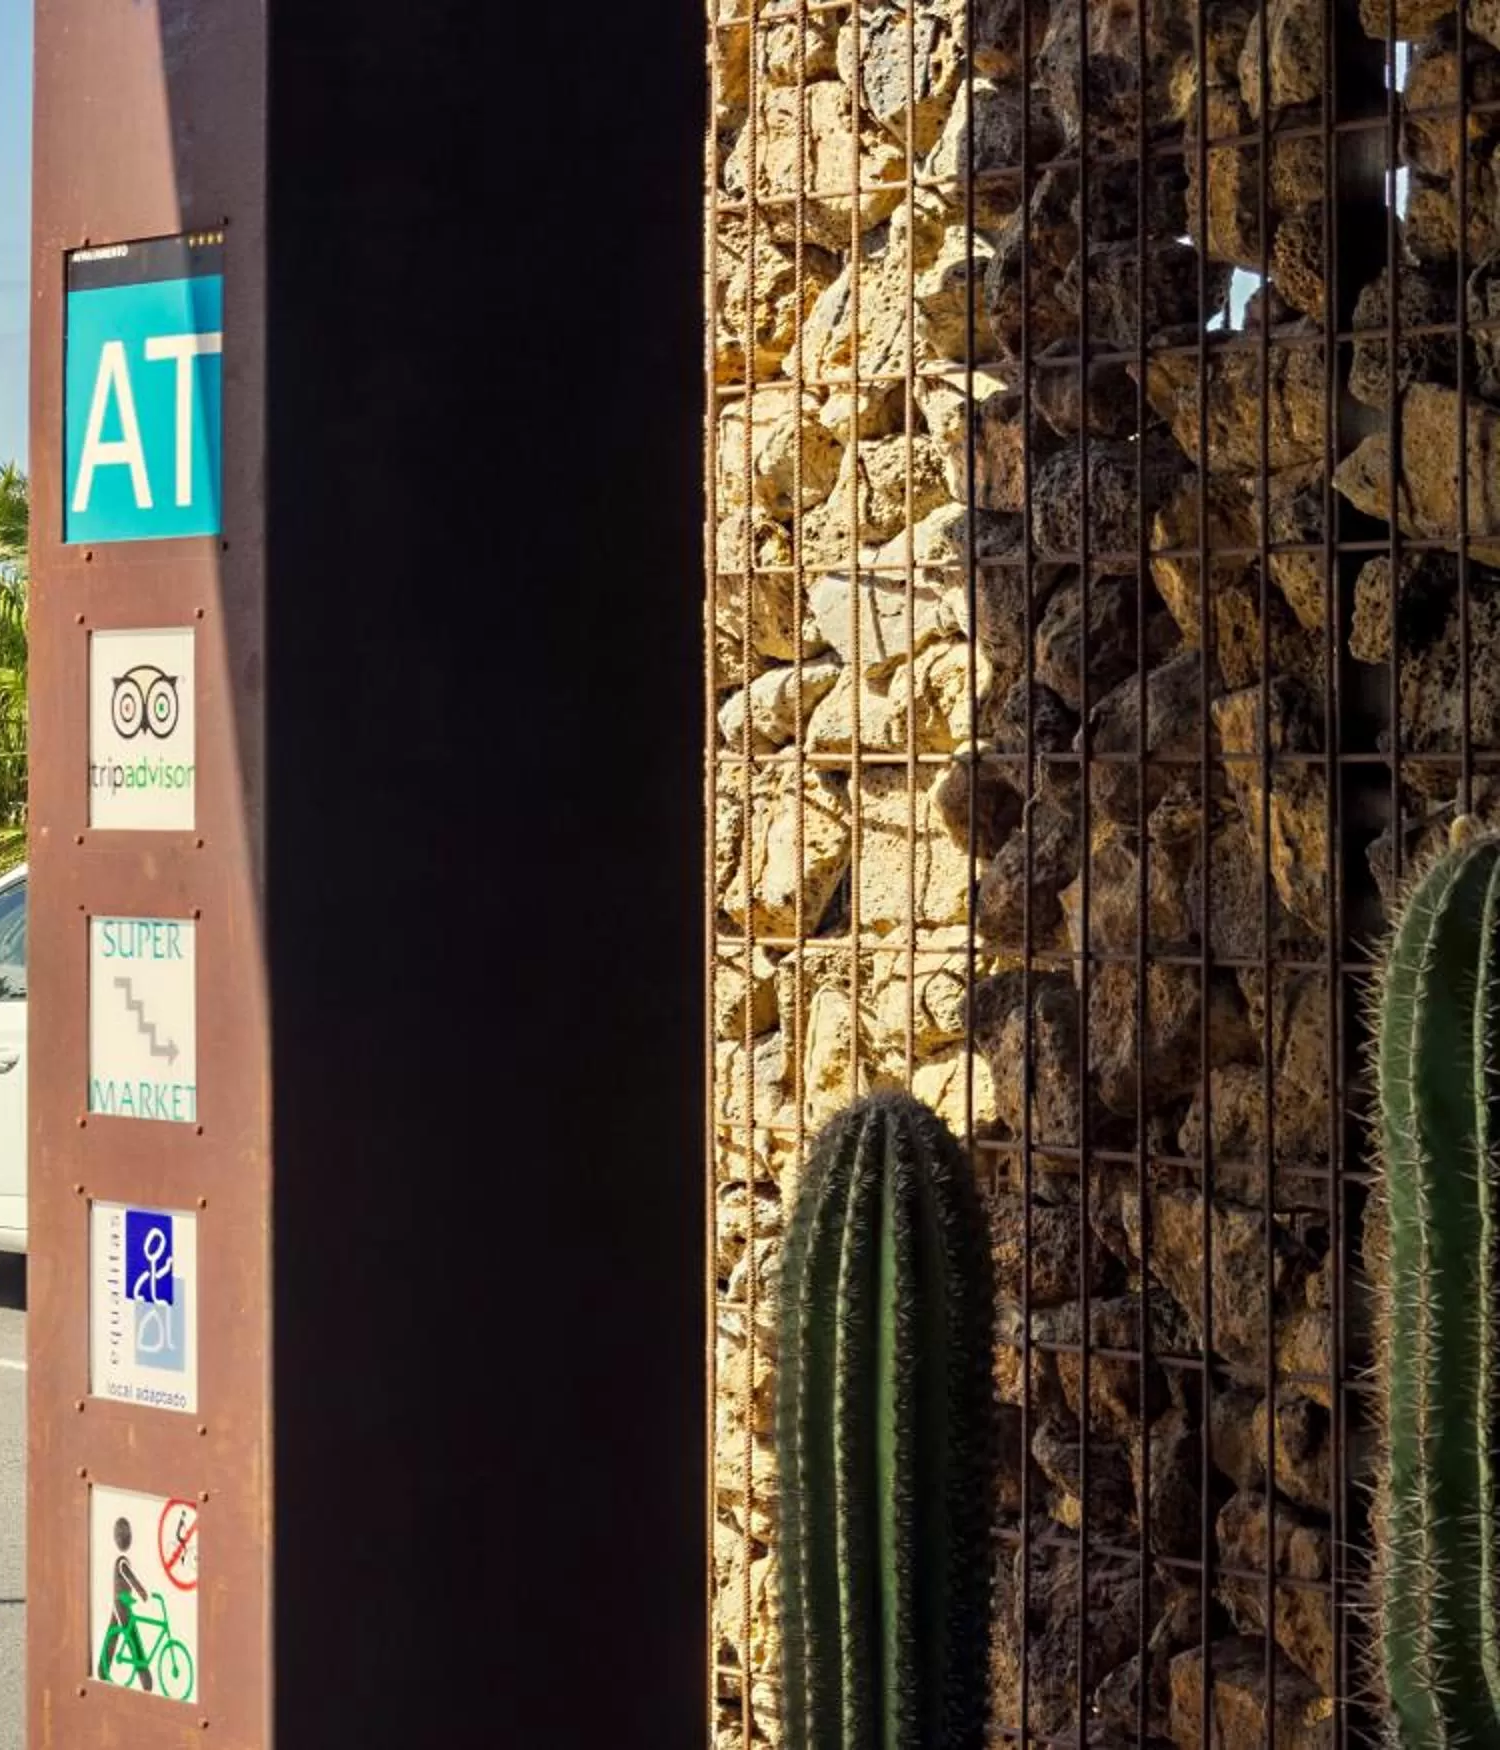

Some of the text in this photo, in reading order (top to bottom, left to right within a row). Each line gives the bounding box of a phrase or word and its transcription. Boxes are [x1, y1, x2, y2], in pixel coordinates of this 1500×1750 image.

[71, 332, 222, 512] AT
[91, 755, 197, 796] tripadvisor
[102, 920, 183, 959] SUPER
[90, 1079, 197, 1121] MARKET
